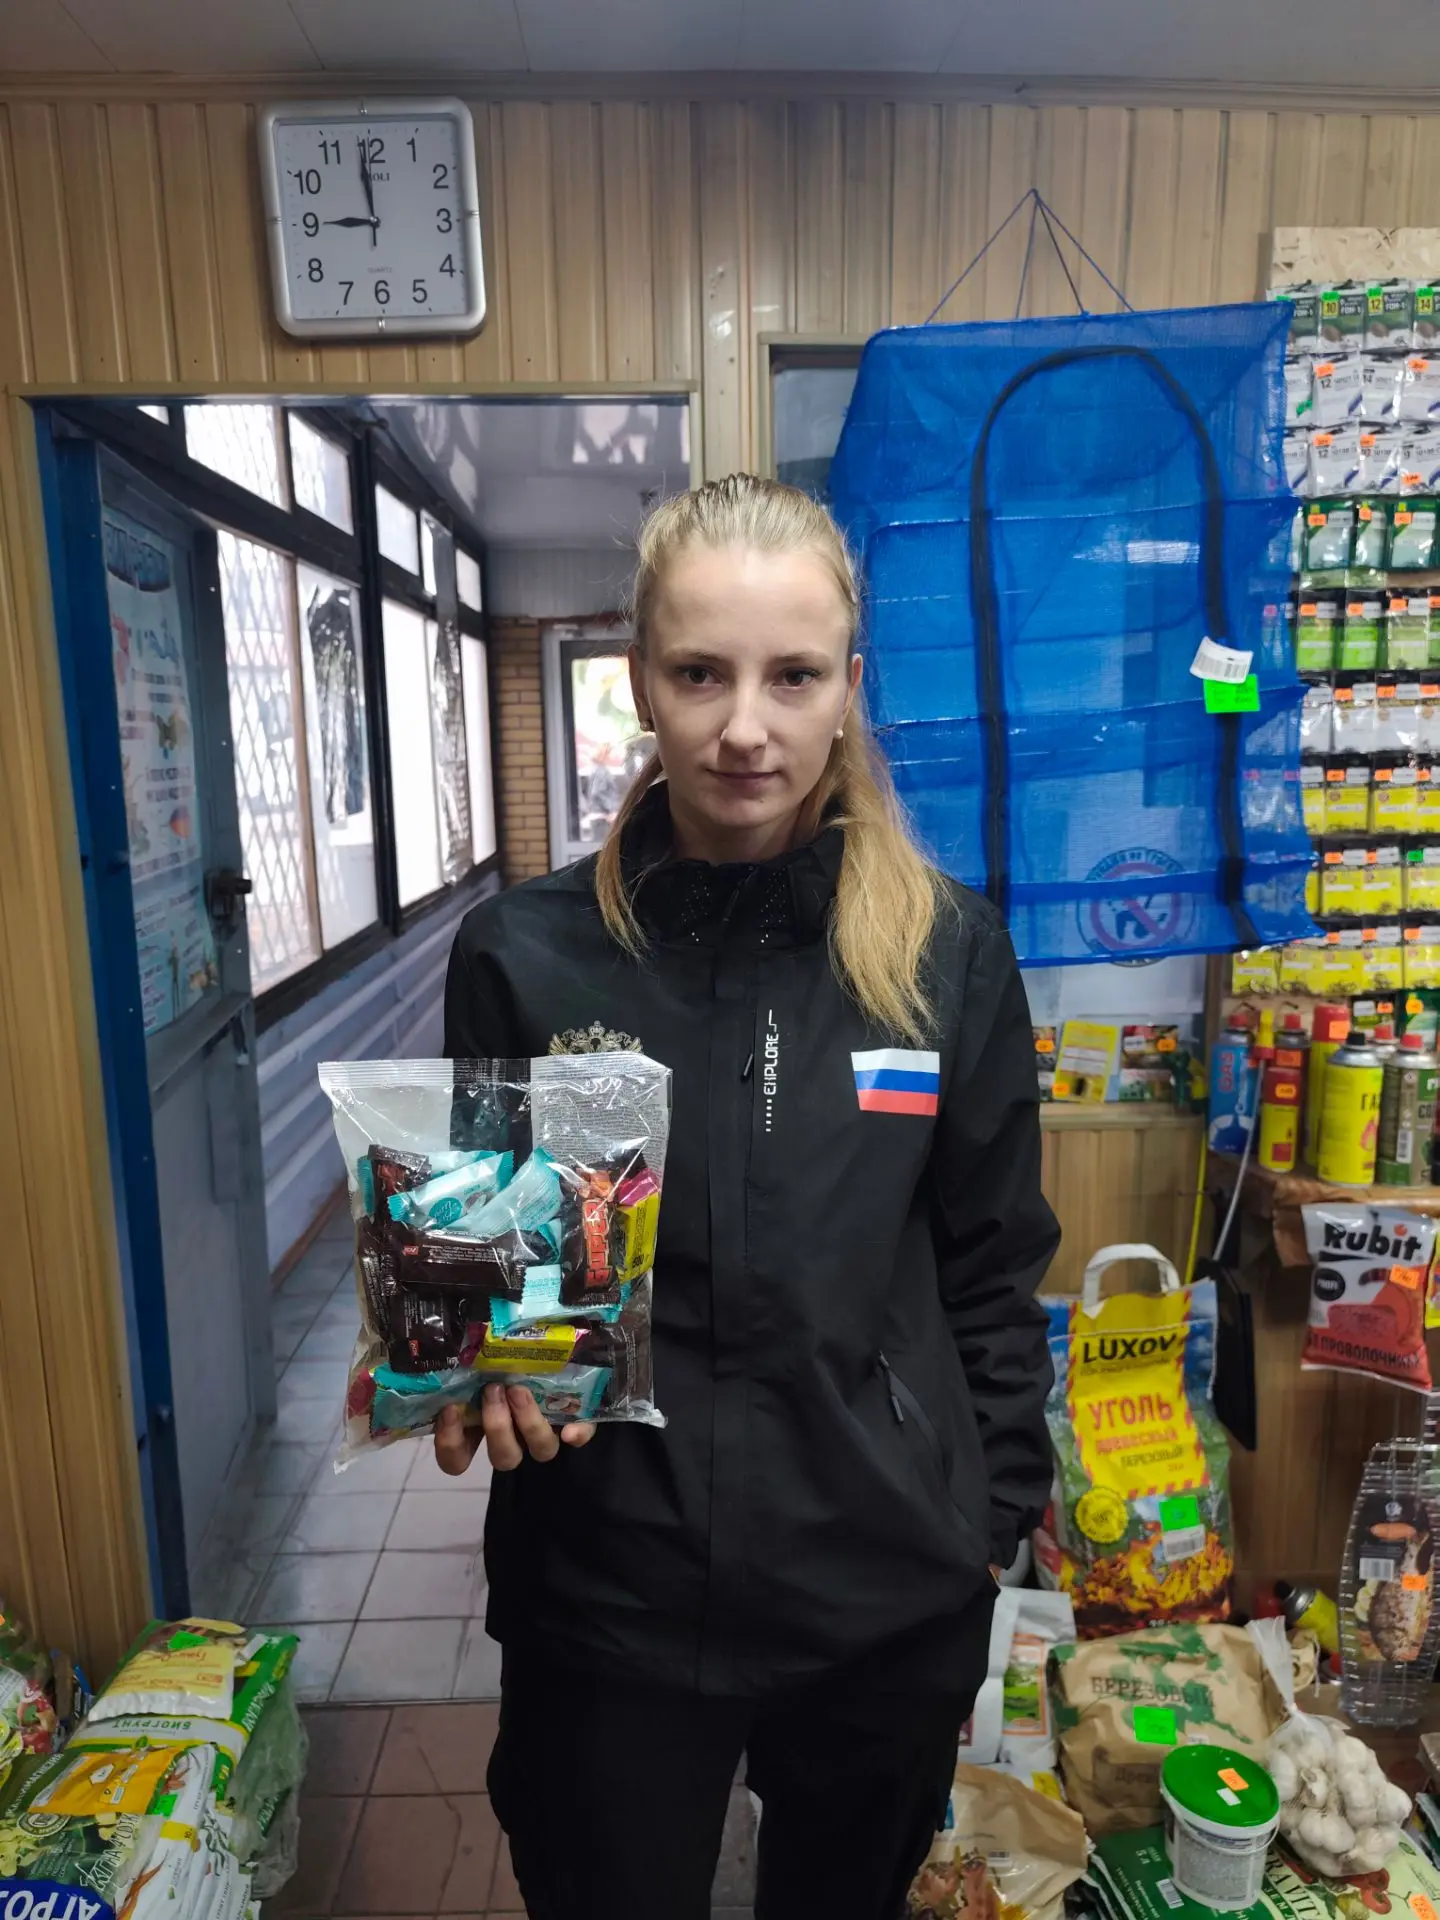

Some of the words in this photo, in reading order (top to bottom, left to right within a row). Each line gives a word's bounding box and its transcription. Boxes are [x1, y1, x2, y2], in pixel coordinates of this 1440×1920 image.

[318, 140, 341, 165] 11
[357, 138, 386, 164] 12
[406, 137, 417, 162] 1
[294, 169, 322, 195] 10
[432, 163, 449, 189] 2
[302, 212, 319, 237] 9
[436, 208, 452, 233] 3
[308, 258, 324, 283] 8
[439, 254, 457, 278] 4
[338, 281, 354, 306] 7
[374, 280, 391, 305] 6
[412, 279, 428, 304] 5
[763, 1033, 780, 1096] EXPLORE
[1218, 1051, 1235, 1092] GAS
[582, 1199, 612, 1288] SUPER
[1324, 1222, 1421, 1261] Rubit
[1083, 1332, 1178, 1364] LUXOV
[1088, 1392, 1172, 1431] УГОЛЬ
[111, 1719, 192, 1730] БИОГРУНТ
[112, 1812, 140, 1840] СОТК
[0, 1890, 102, 1920] АГРО
